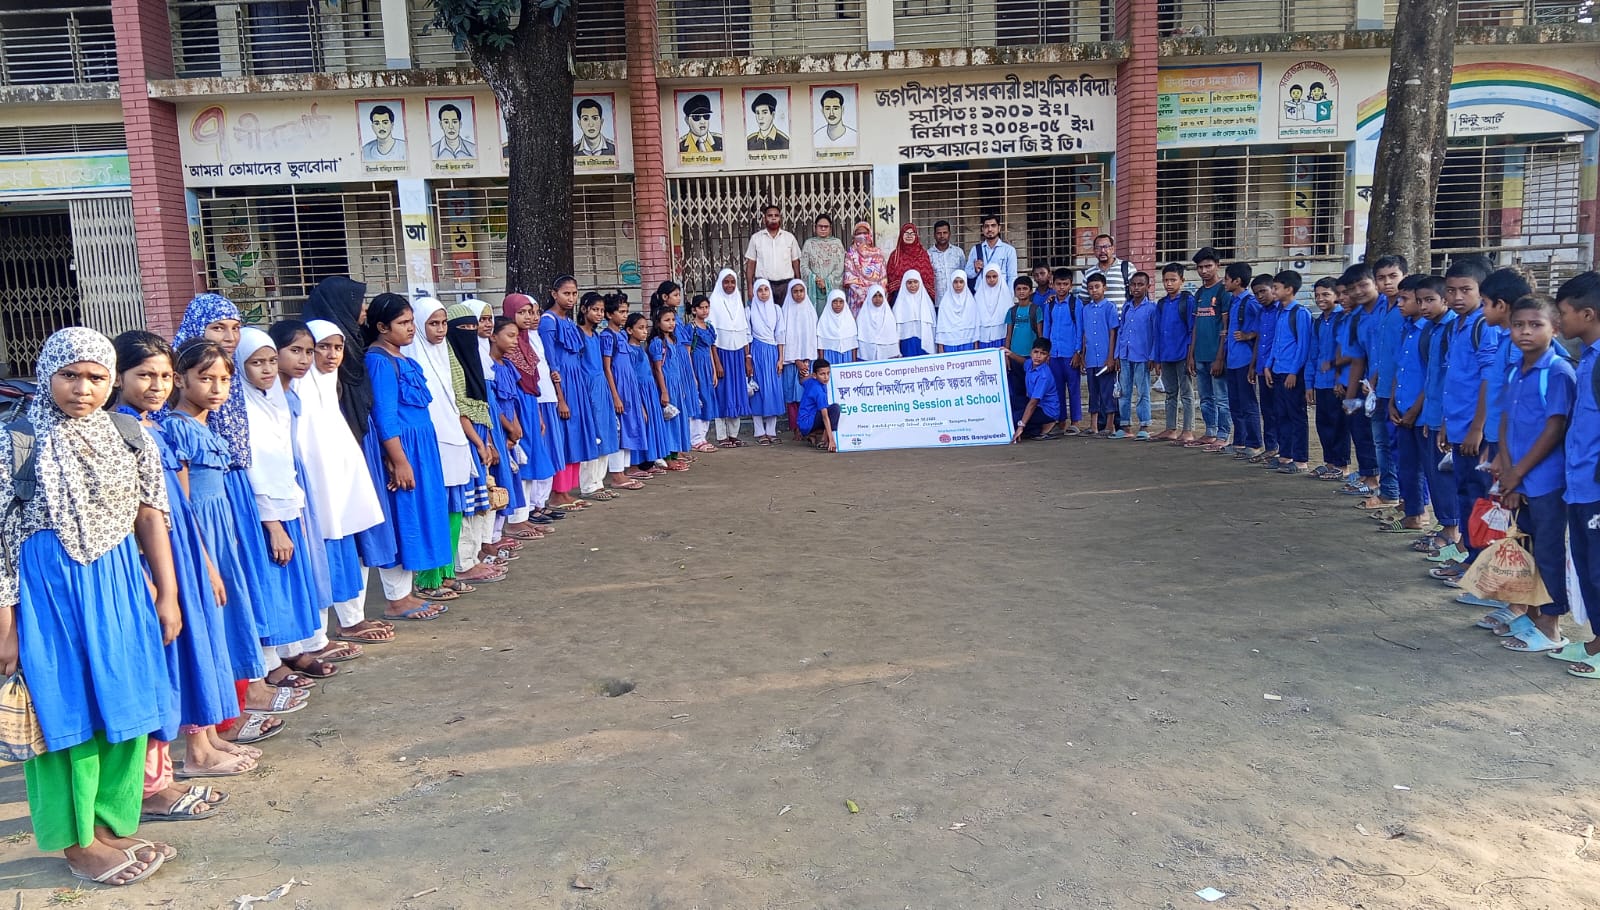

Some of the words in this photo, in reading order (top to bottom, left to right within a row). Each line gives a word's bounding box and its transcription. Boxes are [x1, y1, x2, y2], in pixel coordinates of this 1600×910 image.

[874, 81, 963, 107] জগদীশপুর
[965, 74, 1021, 101] সরকারী
[1023, 74, 1078, 99] প্রাথমিক
[1079, 73, 1117, 96] বিদ্যা
[981, 104, 1034, 118] ১৯০১
[228, 161, 282, 177] তোমাদের
[404, 222, 427, 241] আ
[840, 370, 863, 379] RDRS
[864, 370, 883, 378] Core
[885, 363, 945, 376] Comprehensive
[947, 358, 992, 370] Programme
[840, 403, 858, 415] Eye
[861, 401, 910, 413] Screening
[912, 398, 952, 410] Session
[954, 395, 964, 407] at
[966, 392, 1001, 405] School
[971, 432, 1007, 441] Bangladesh
